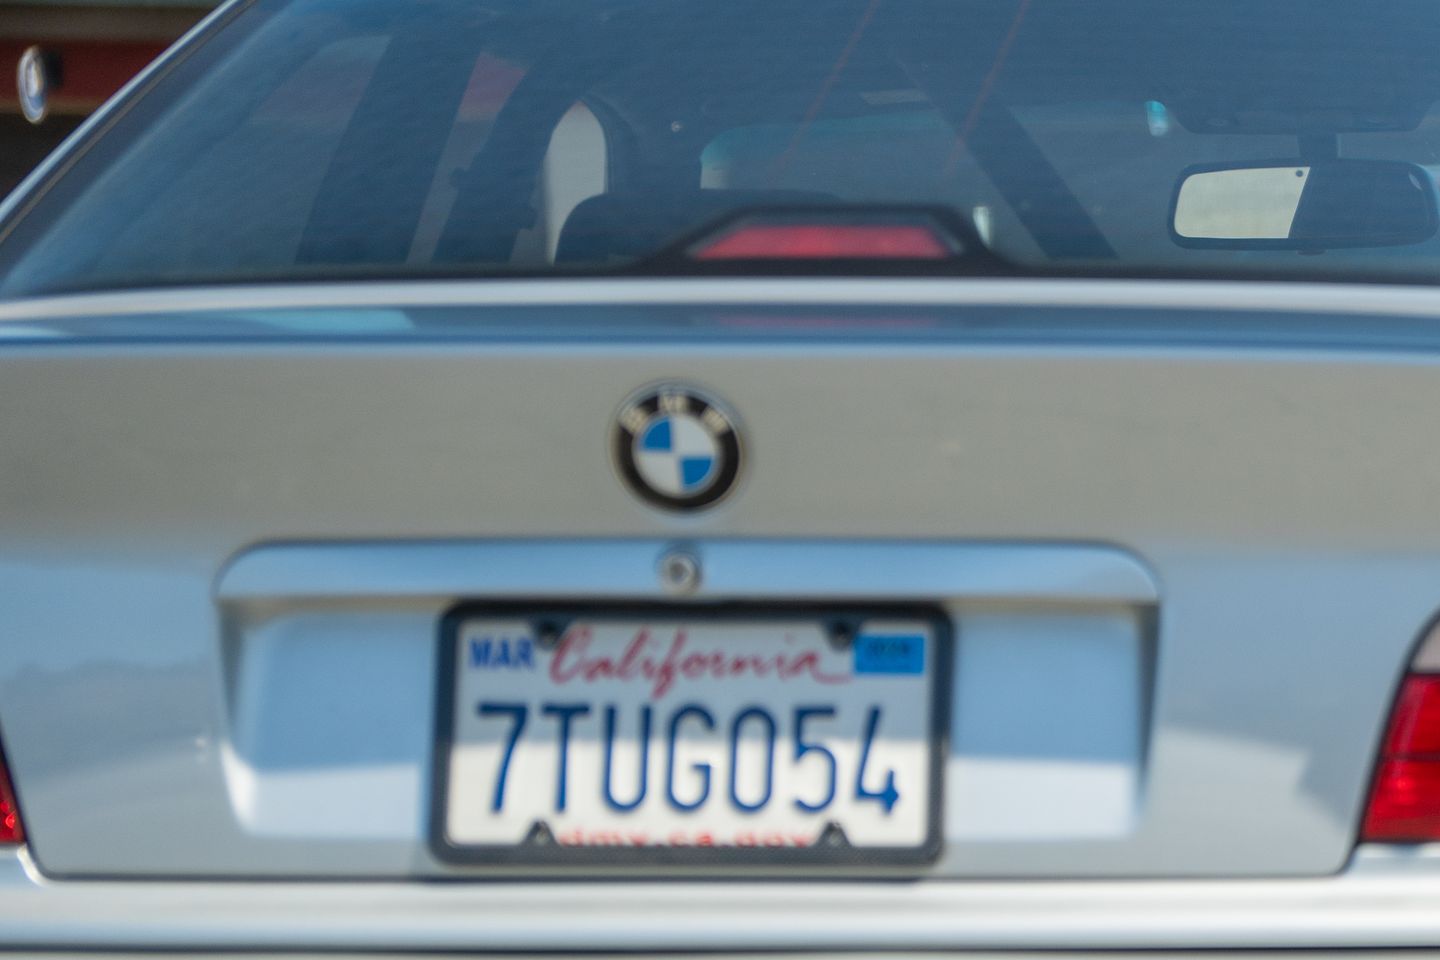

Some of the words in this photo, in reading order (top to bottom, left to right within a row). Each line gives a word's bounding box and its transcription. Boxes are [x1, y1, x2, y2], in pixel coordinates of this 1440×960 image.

[468, 636, 536, 671] MAR
[549, 622, 853, 700] California
[476, 702, 900, 816] 7TUG054
